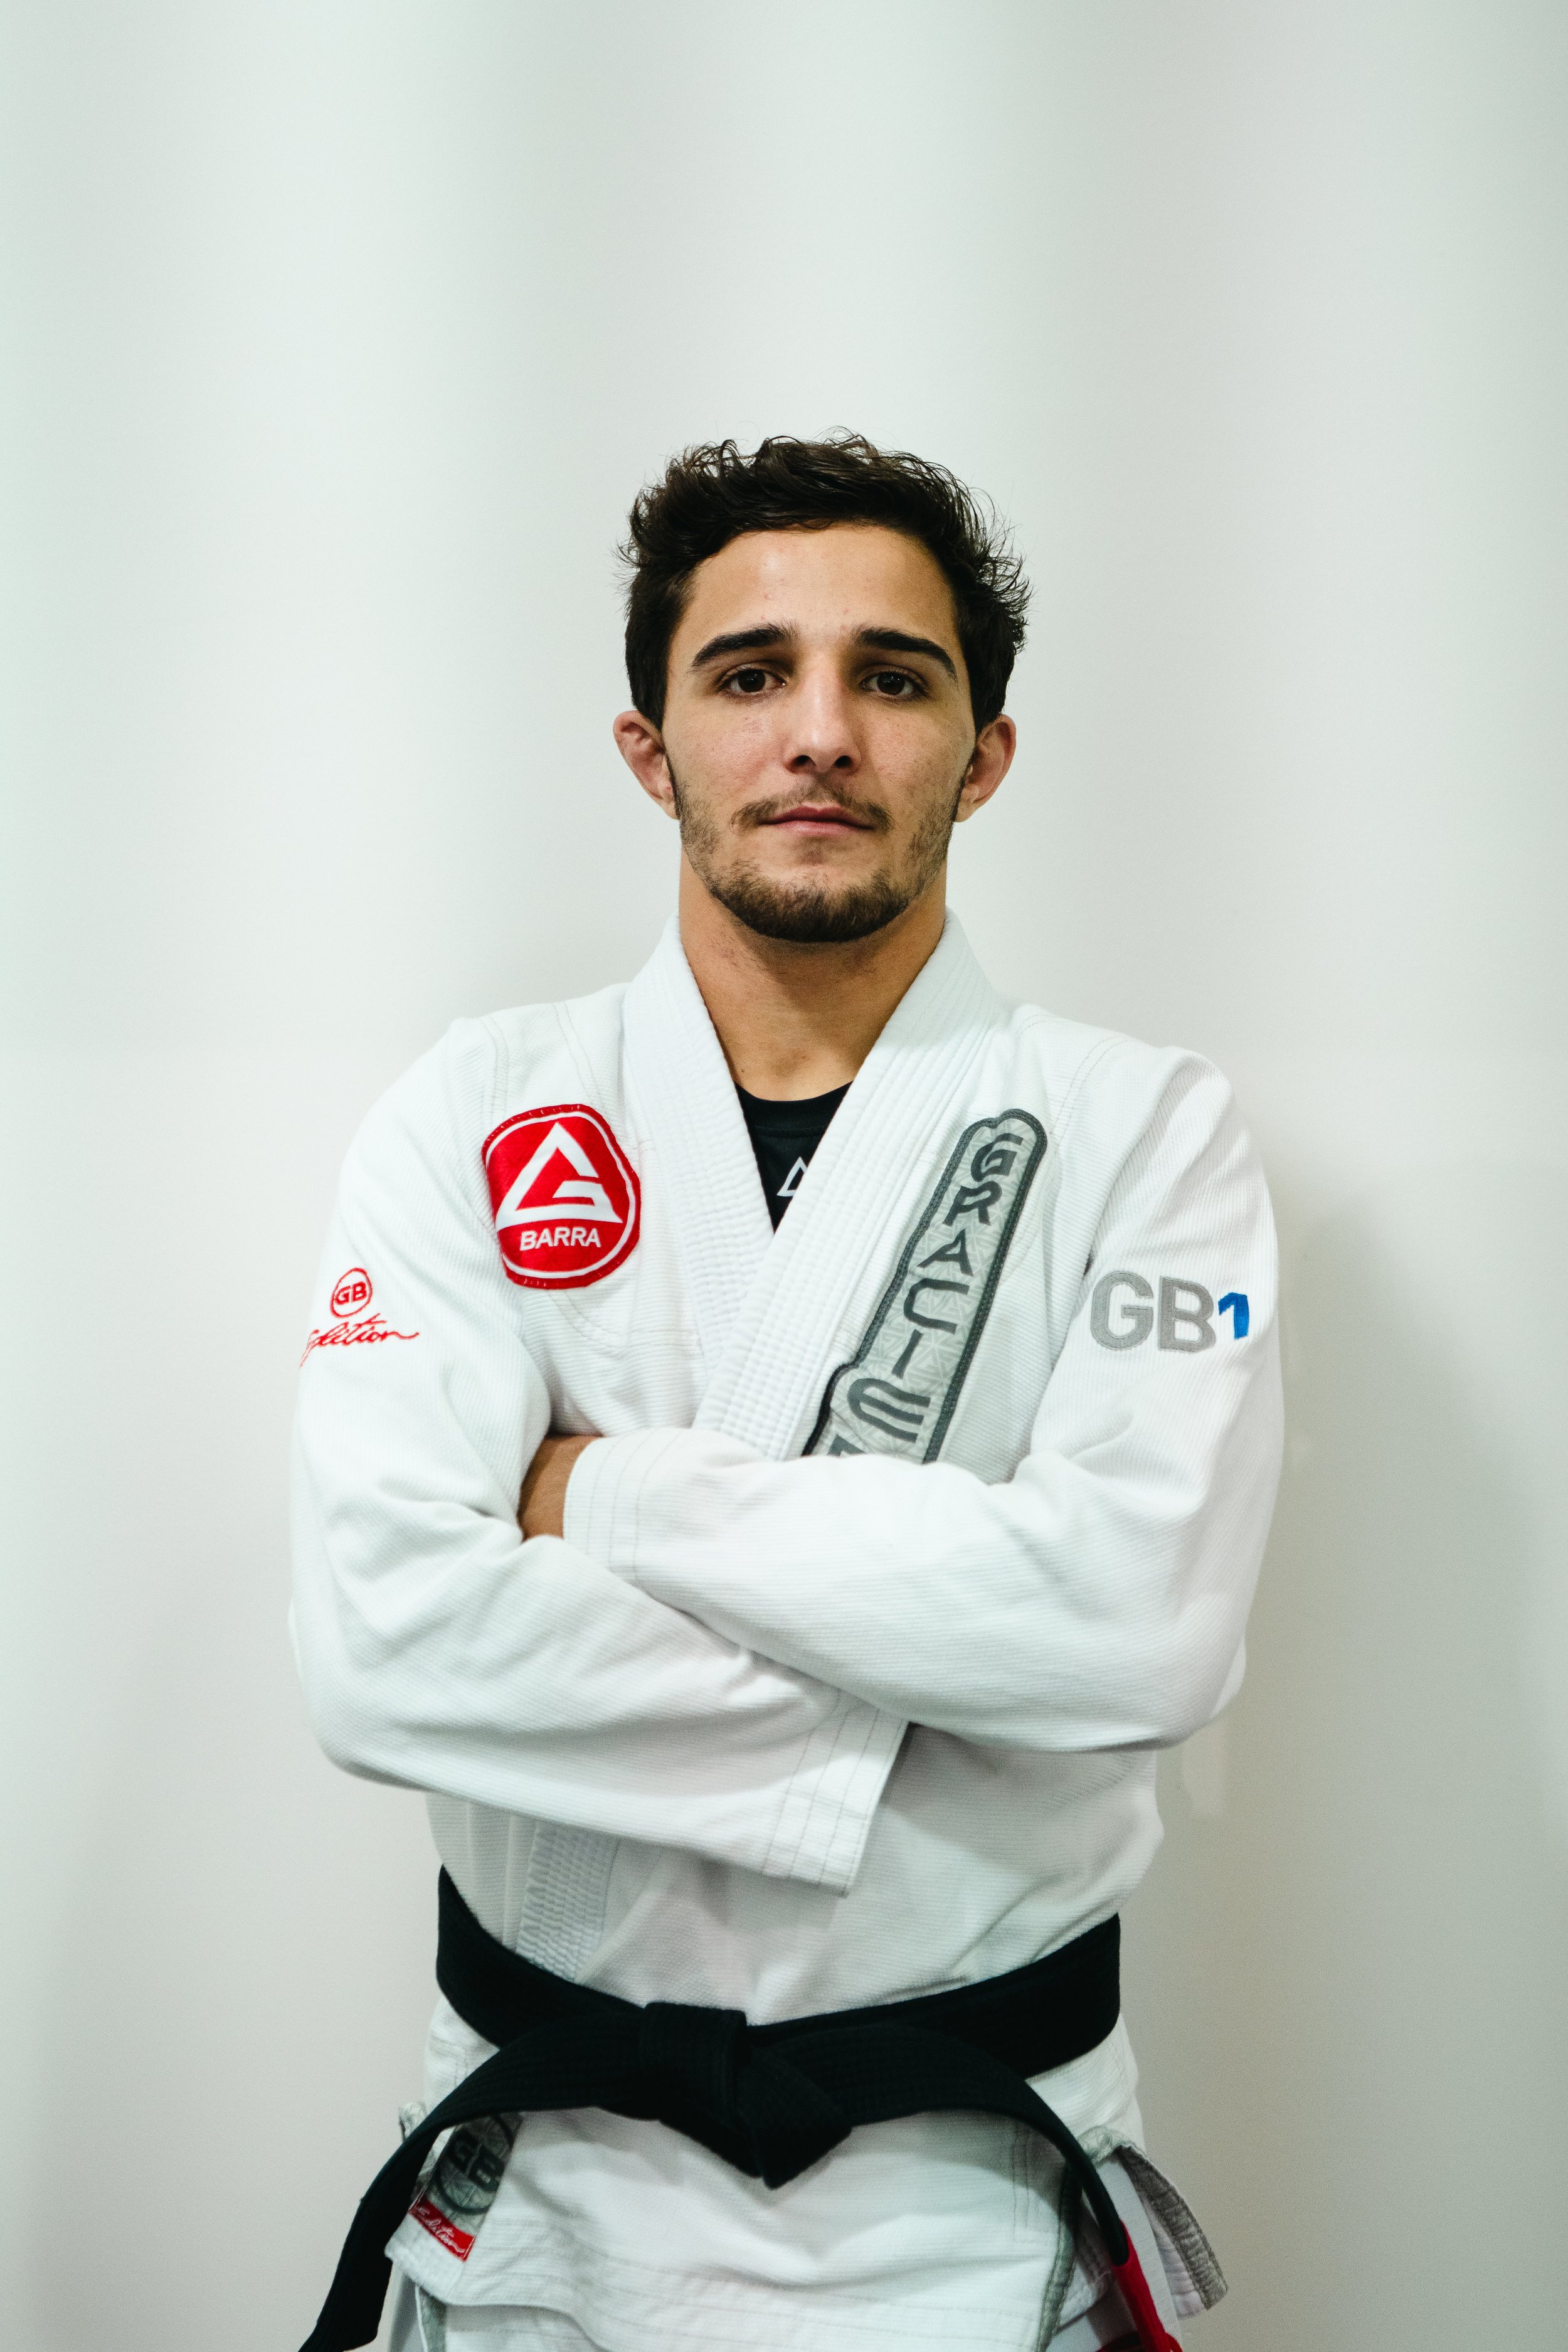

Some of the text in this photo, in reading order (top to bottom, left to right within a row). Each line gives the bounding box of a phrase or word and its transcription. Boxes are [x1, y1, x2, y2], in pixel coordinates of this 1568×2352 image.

[520, 1226, 601, 1251] BARRA
[335, 1281, 367, 1305] GB
[846, 1133, 1023, 1443] GRACIE
[446, 2129, 506, 2192] GB
